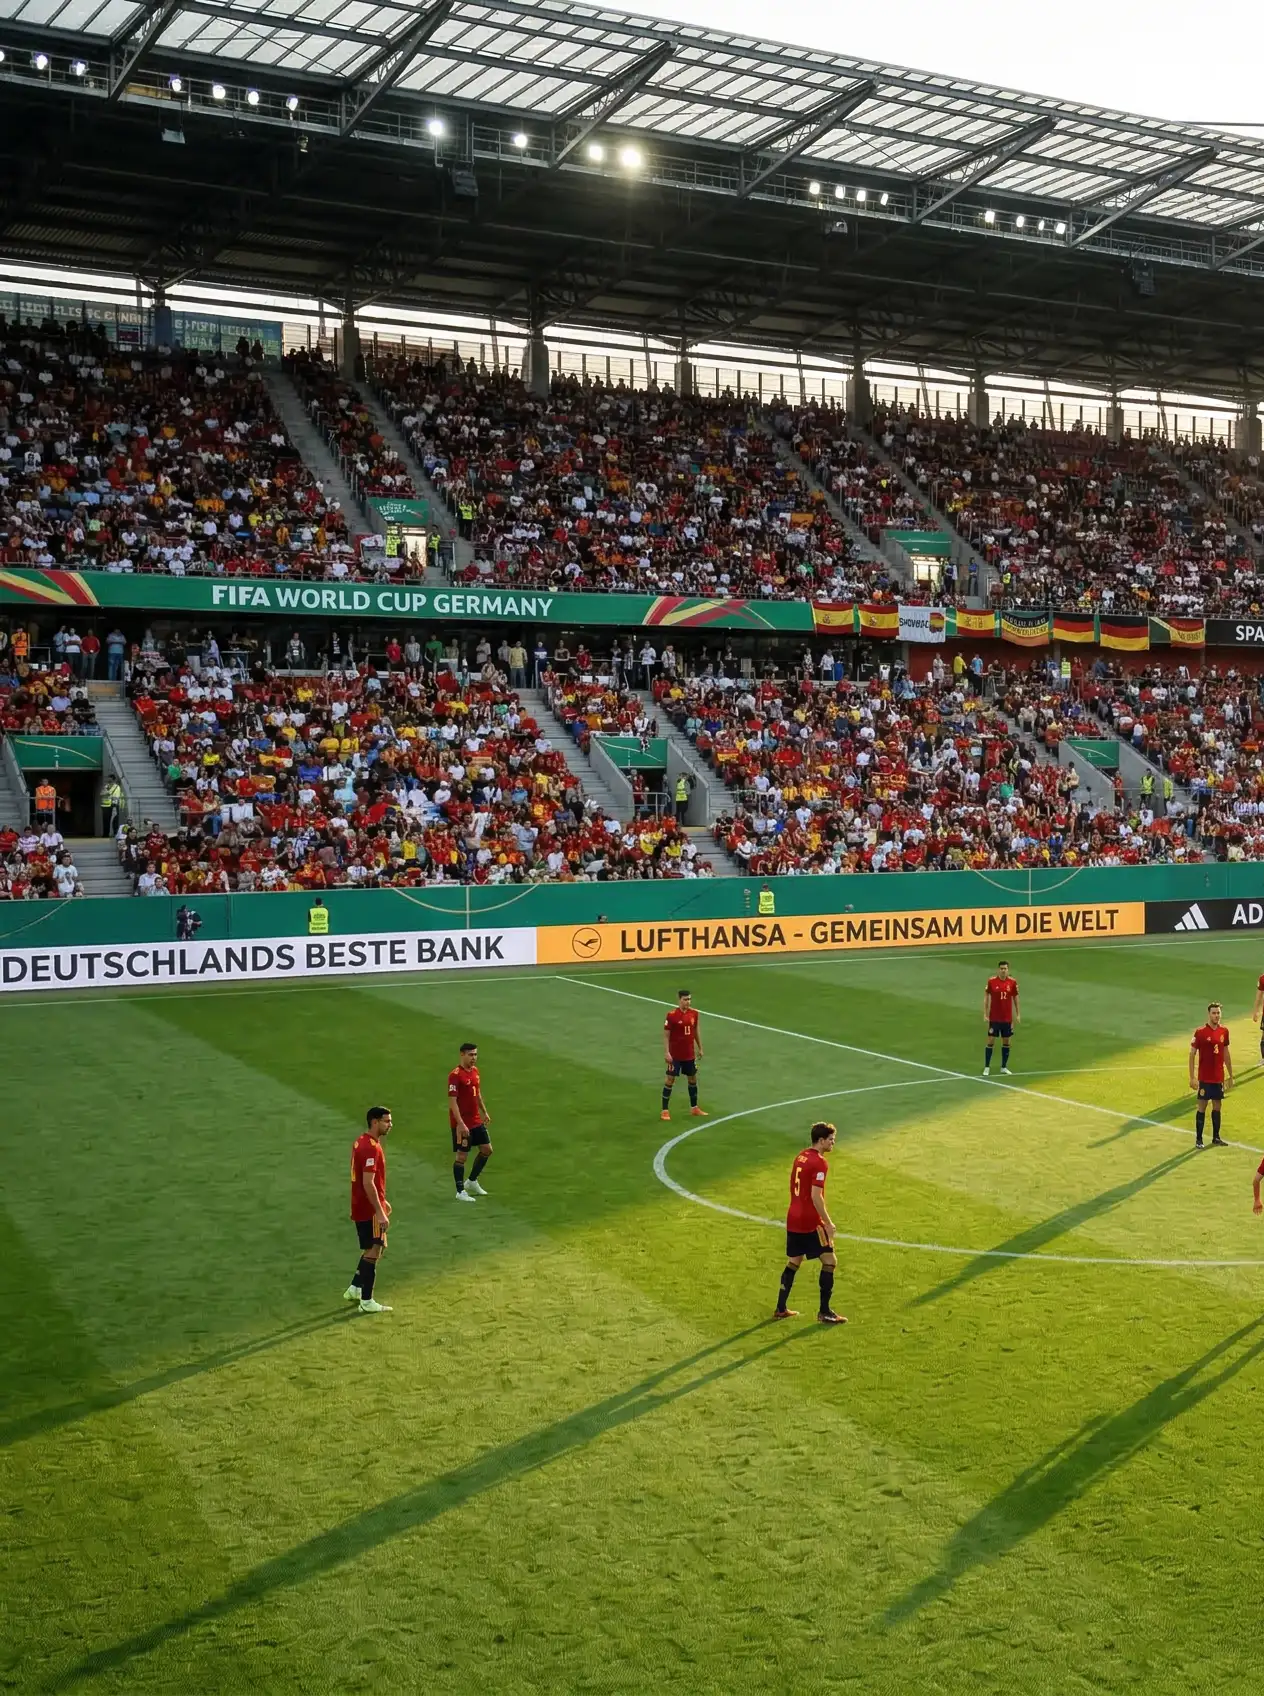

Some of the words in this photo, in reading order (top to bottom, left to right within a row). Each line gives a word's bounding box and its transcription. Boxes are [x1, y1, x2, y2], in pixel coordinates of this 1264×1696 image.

[212, 585, 271, 607] FIFA
[275, 587, 371, 610] WORLD
[377, 592, 427, 612] CUP
[433, 594, 553, 617] GERMANY
[620, 923, 786, 953] LUFTHANSA
[810, 915, 963, 944] GEMEINSAM
[971, 913, 1008, 936] UM
[1015, 912, 1052, 934] DIE
[1058, 909, 1119, 932] WELT
[3, 944, 295, 983] DEUTSCHLANDS
[306, 939, 407, 969] BESTE
[417, 935, 504, 963] BANK
[794, 1166, 802, 1197] 5
